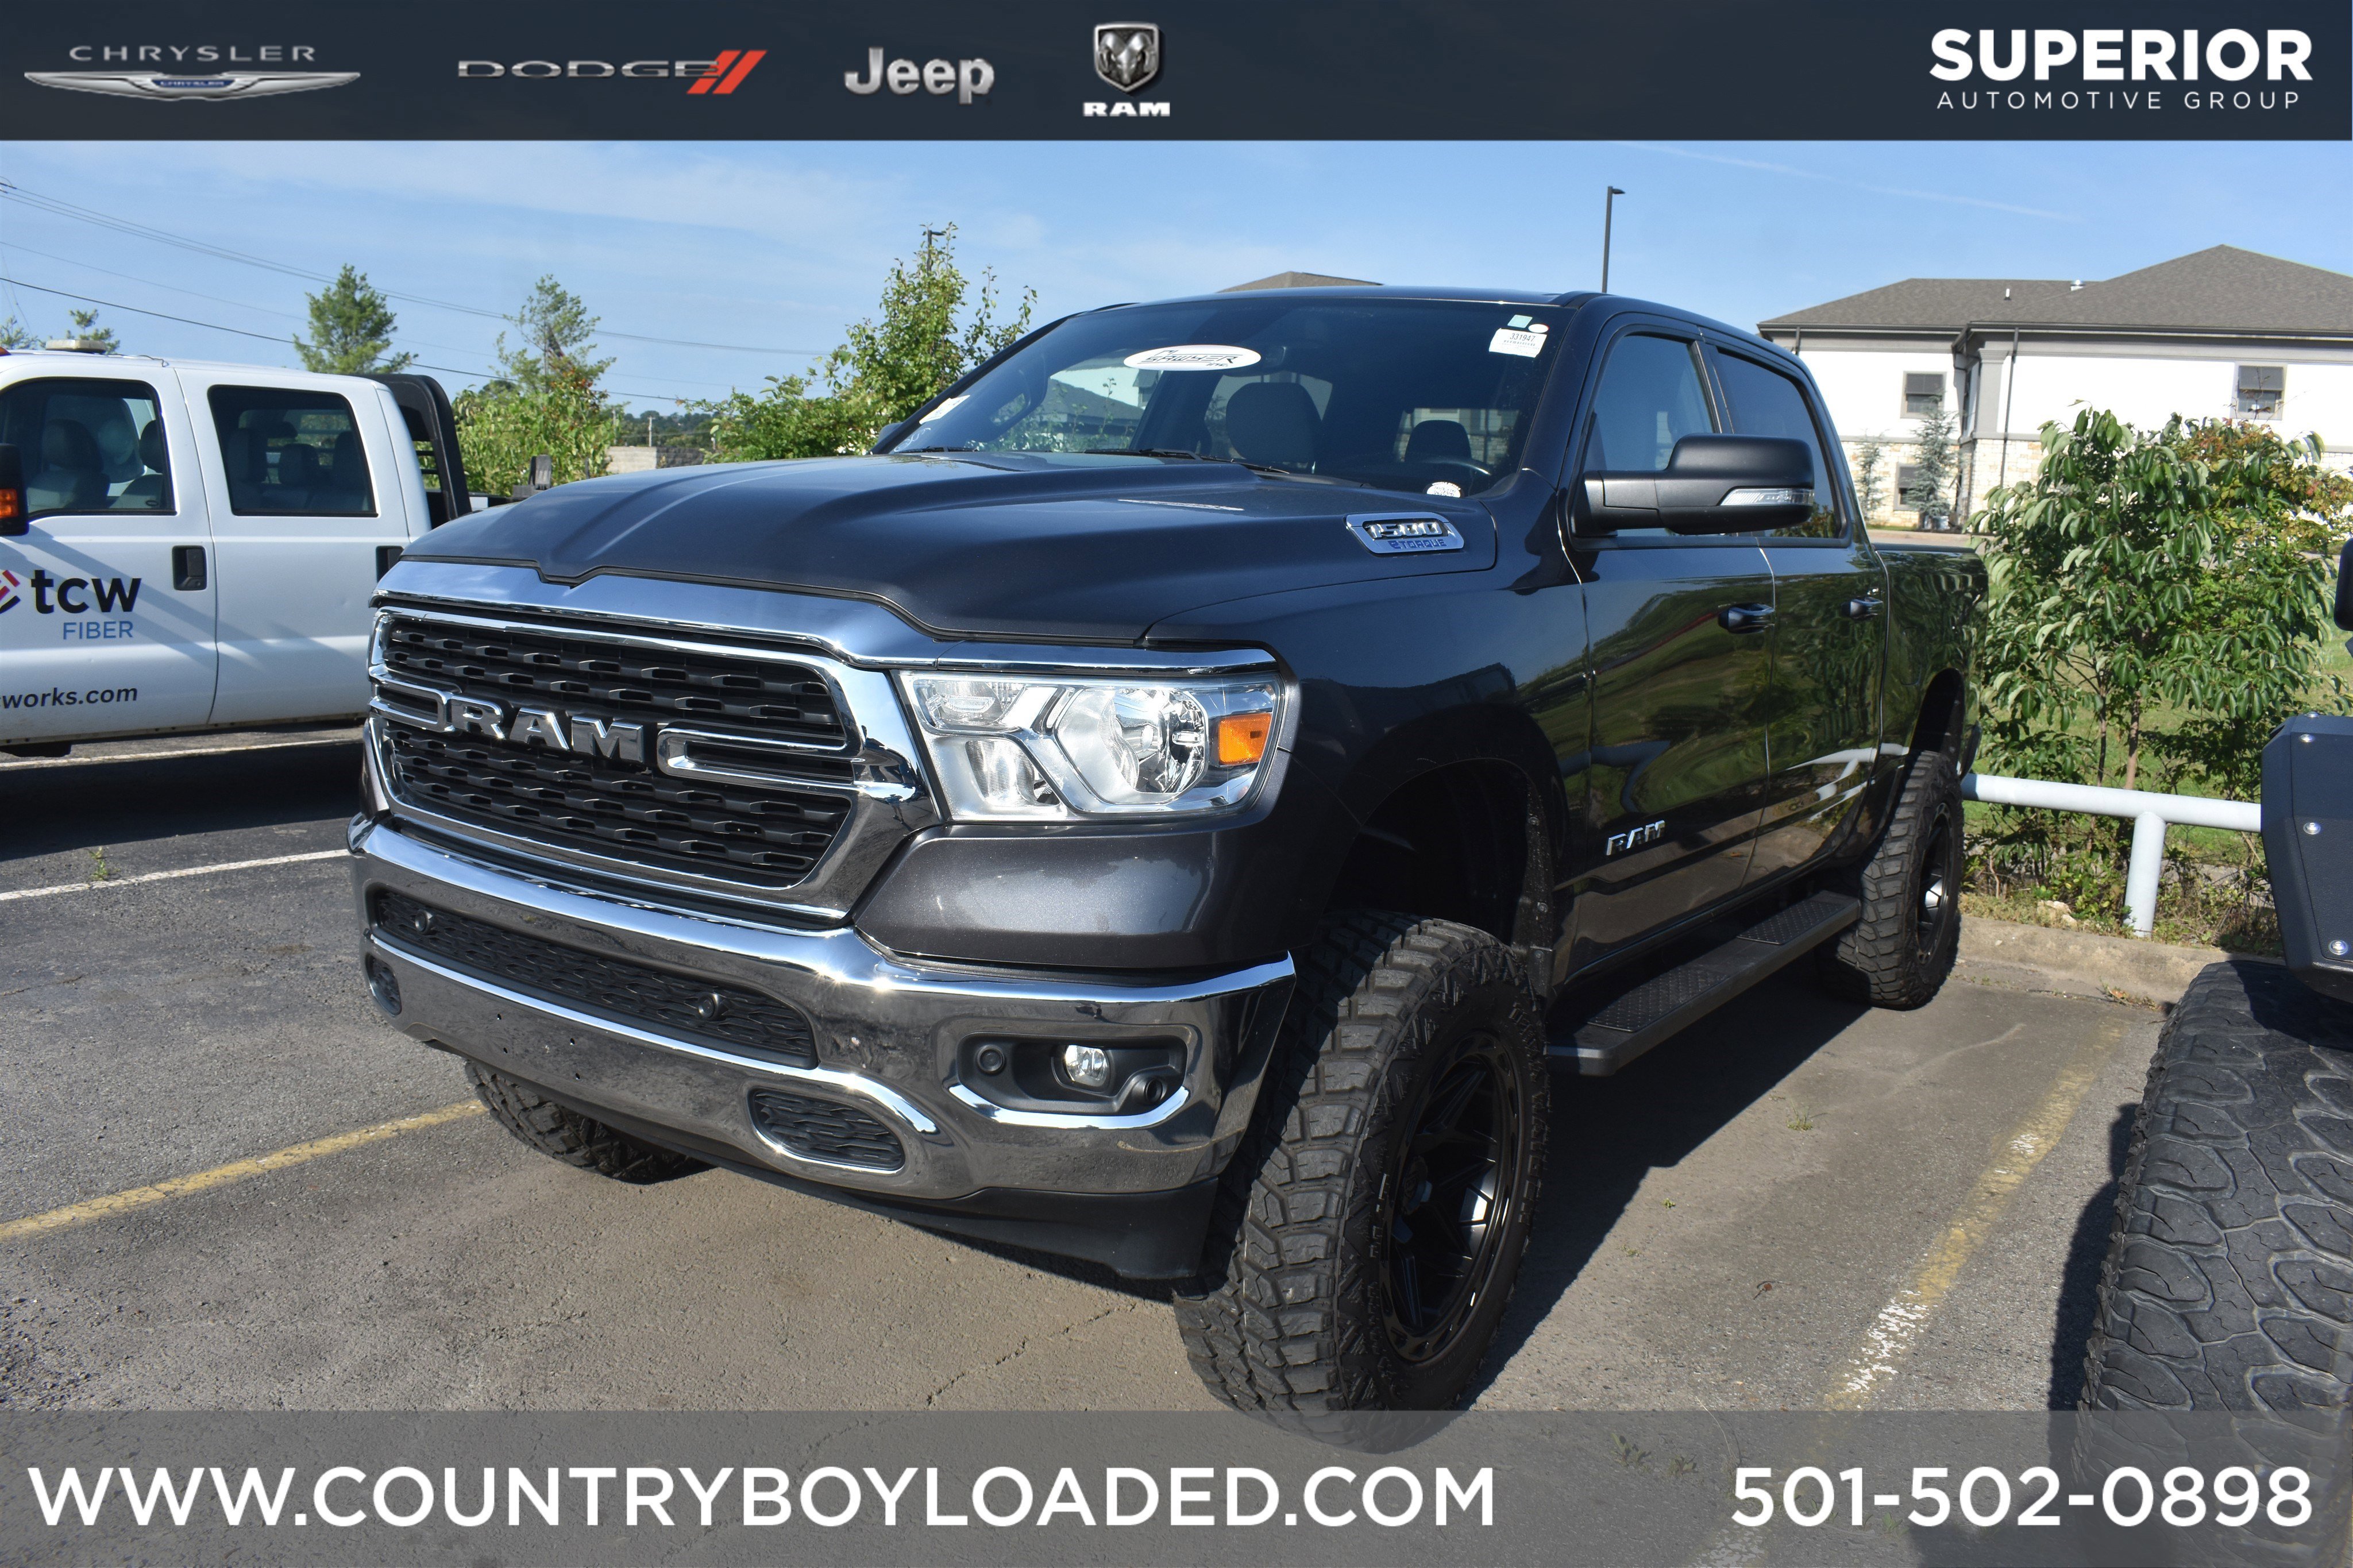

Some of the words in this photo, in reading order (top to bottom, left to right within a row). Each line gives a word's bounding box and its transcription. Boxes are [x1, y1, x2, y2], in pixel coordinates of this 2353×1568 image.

[1510, 333, 1536, 343] 331947
[1365, 522, 1442, 539] 1500
[31, 570, 142, 614] tcw
[63, 621, 134, 640] FIBER
[0, 688, 137, 709] works.com
[451, 694, 645, 763] RAM
[1606, 820, 1665, 856] RAM
